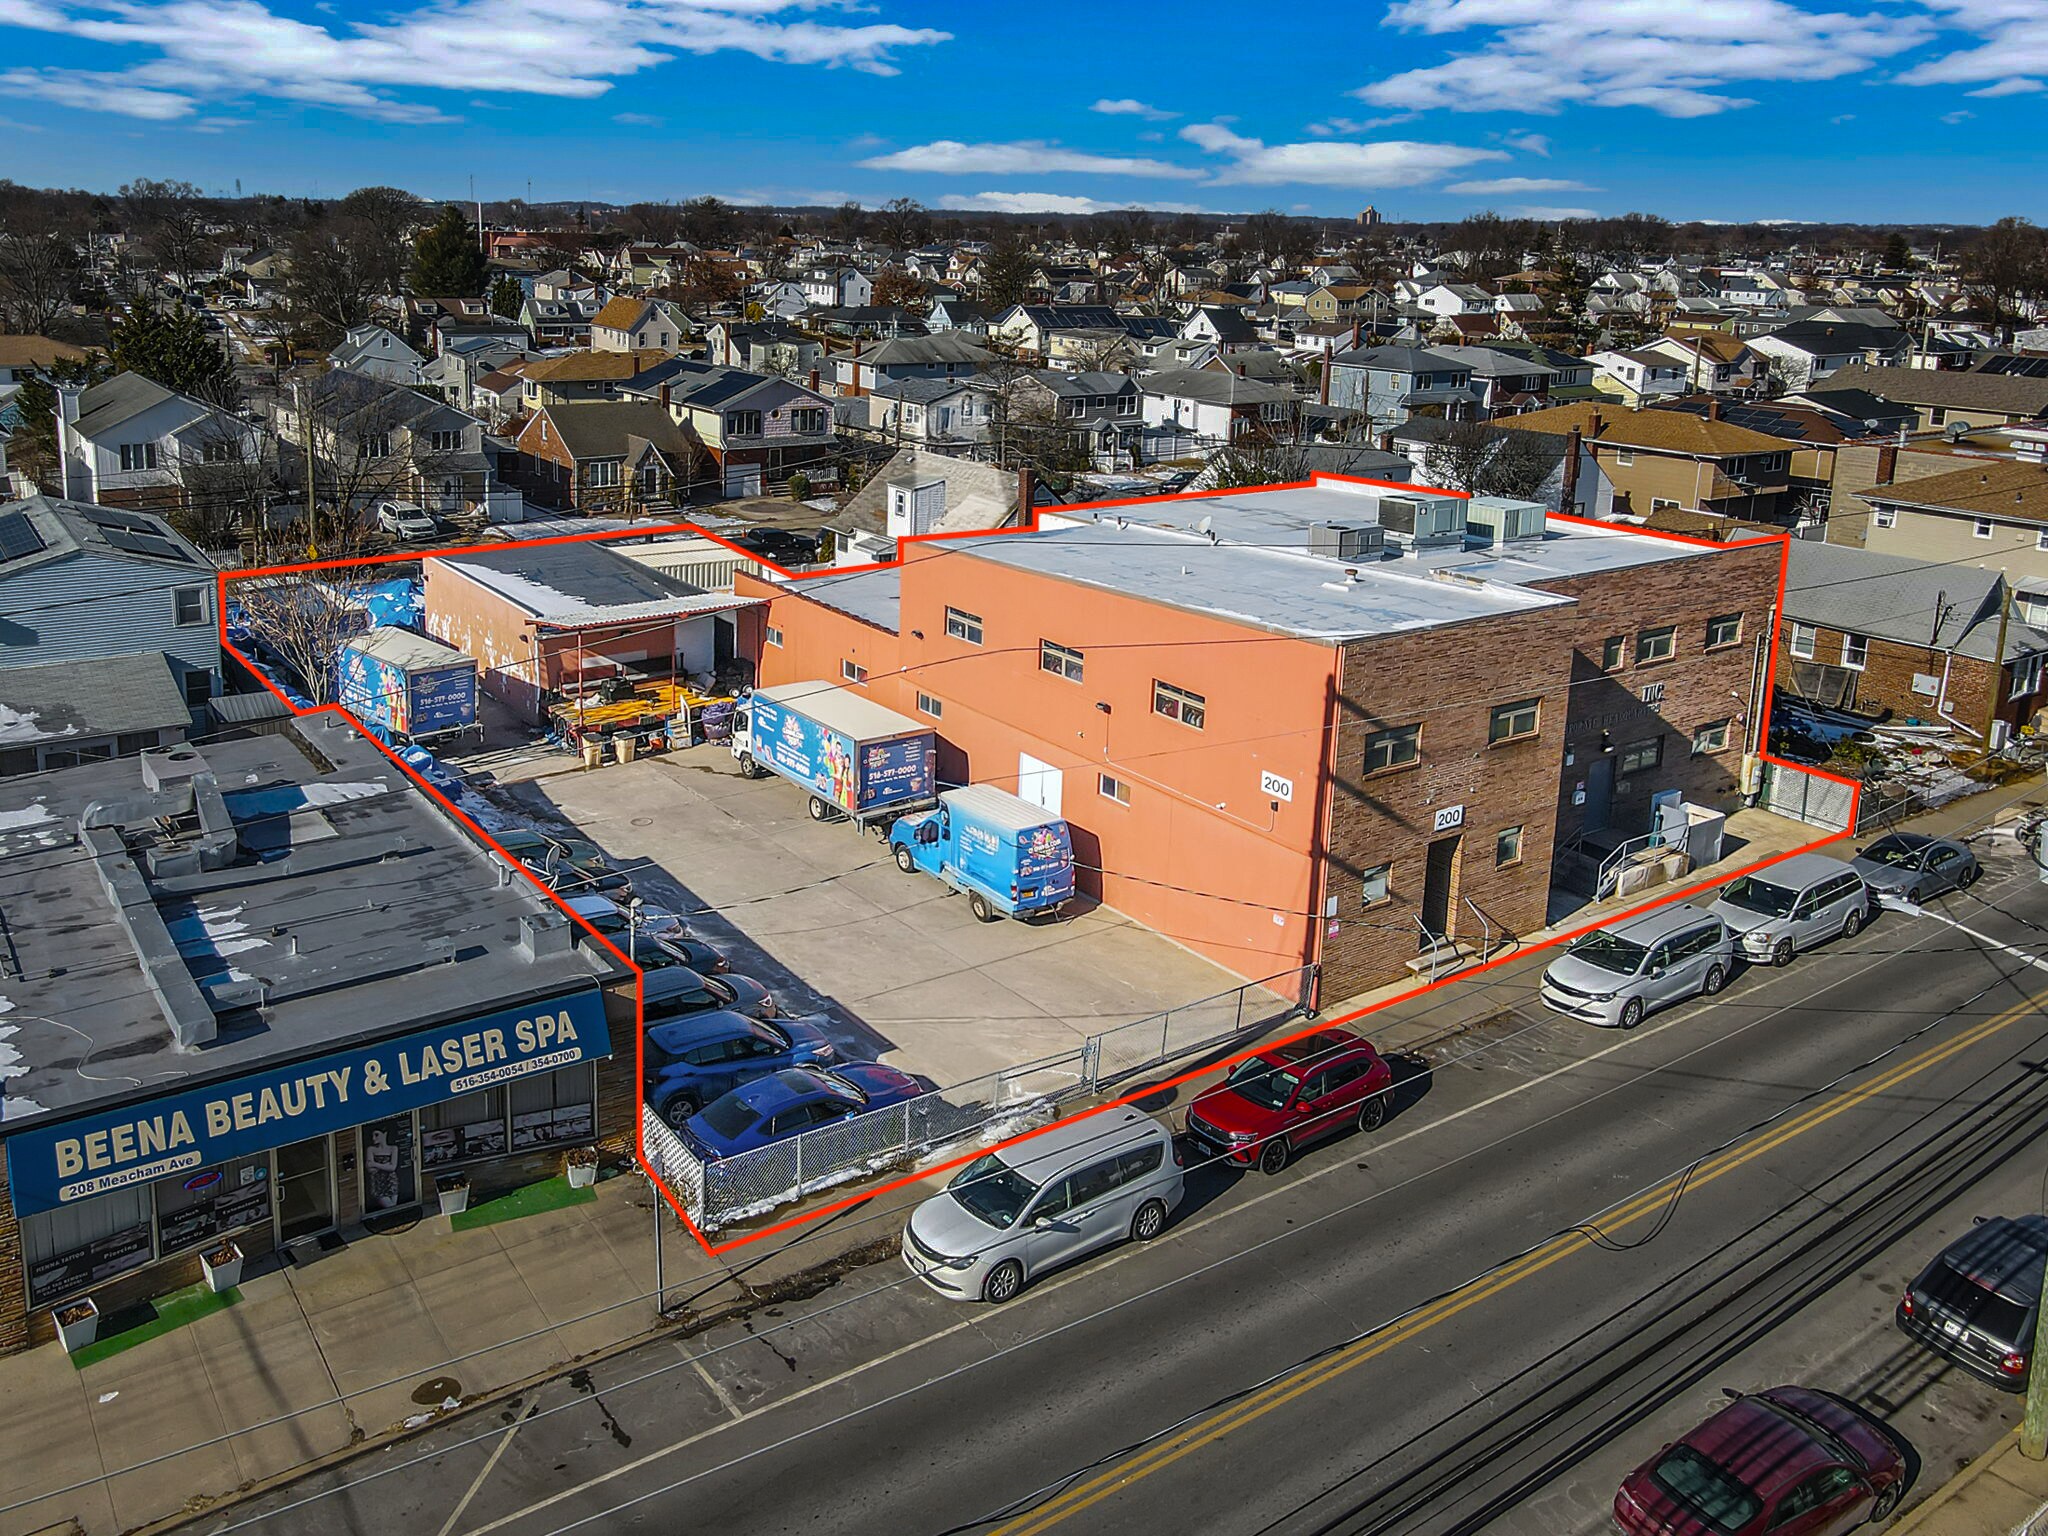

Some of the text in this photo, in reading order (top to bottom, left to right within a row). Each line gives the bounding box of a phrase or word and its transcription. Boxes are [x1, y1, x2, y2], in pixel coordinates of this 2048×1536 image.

[868, 764, 917, 780] 516-577-0000
[1264, 776, 1289, 796] 200
[1438, 809, 1460, 826] 200
[456, 1064, 524, 1090] 516-354-0054
[531, 1050, 576, 1069] 354-0700
[55, 1010, 578, 1178] BEENA BEAUTY & LASER SPA
[69, 1157, 193, 1197] 208 Meacham Ave
[36, 1250, 85, 1273] HENNA TATTOO
[103, 1243, 138, 1259] Piercing
